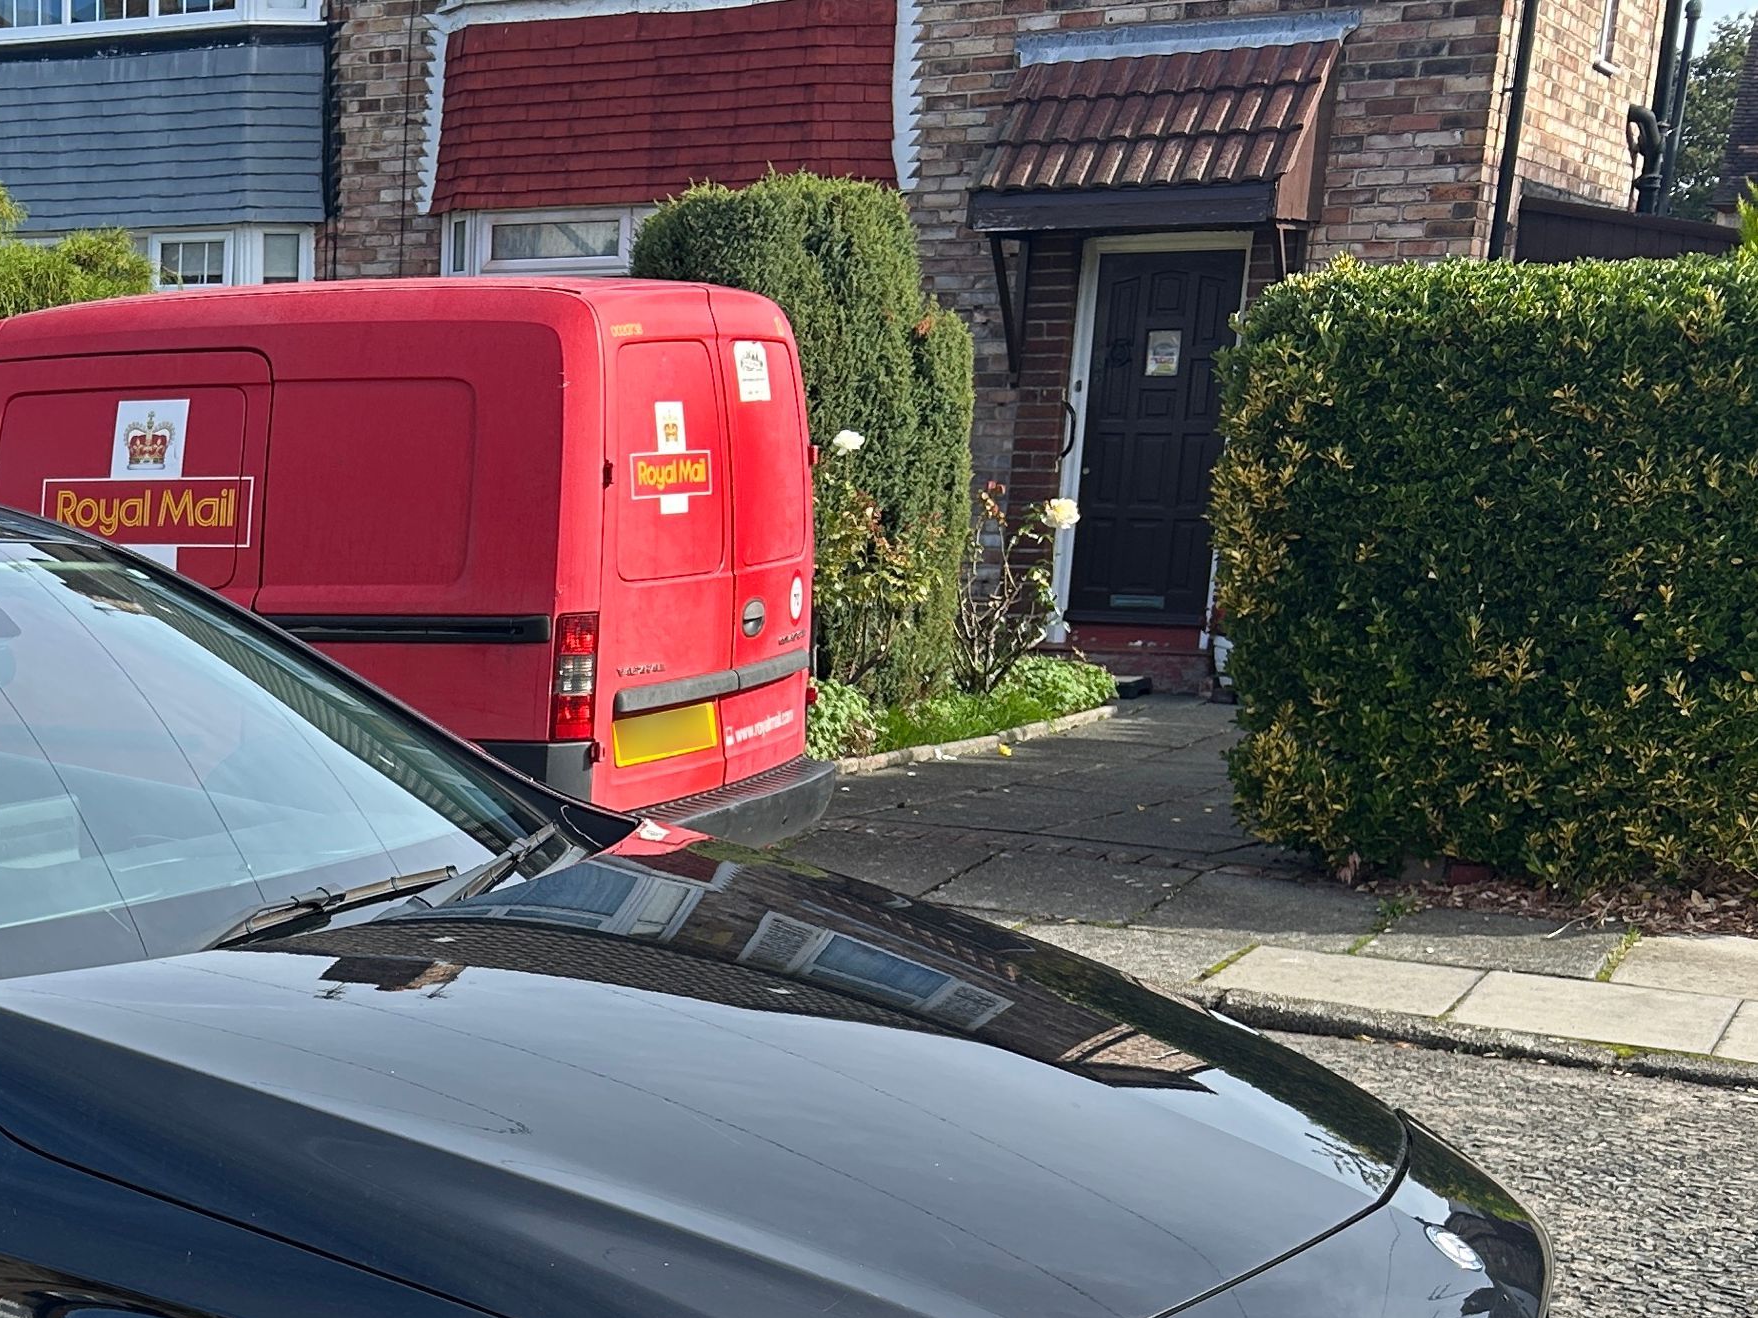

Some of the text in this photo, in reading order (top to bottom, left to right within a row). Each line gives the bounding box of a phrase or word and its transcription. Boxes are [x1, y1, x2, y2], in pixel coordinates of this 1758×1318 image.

[637, 458, 707, 491] Royal Mail
[56, 488, 236, 537] Royal Mail
